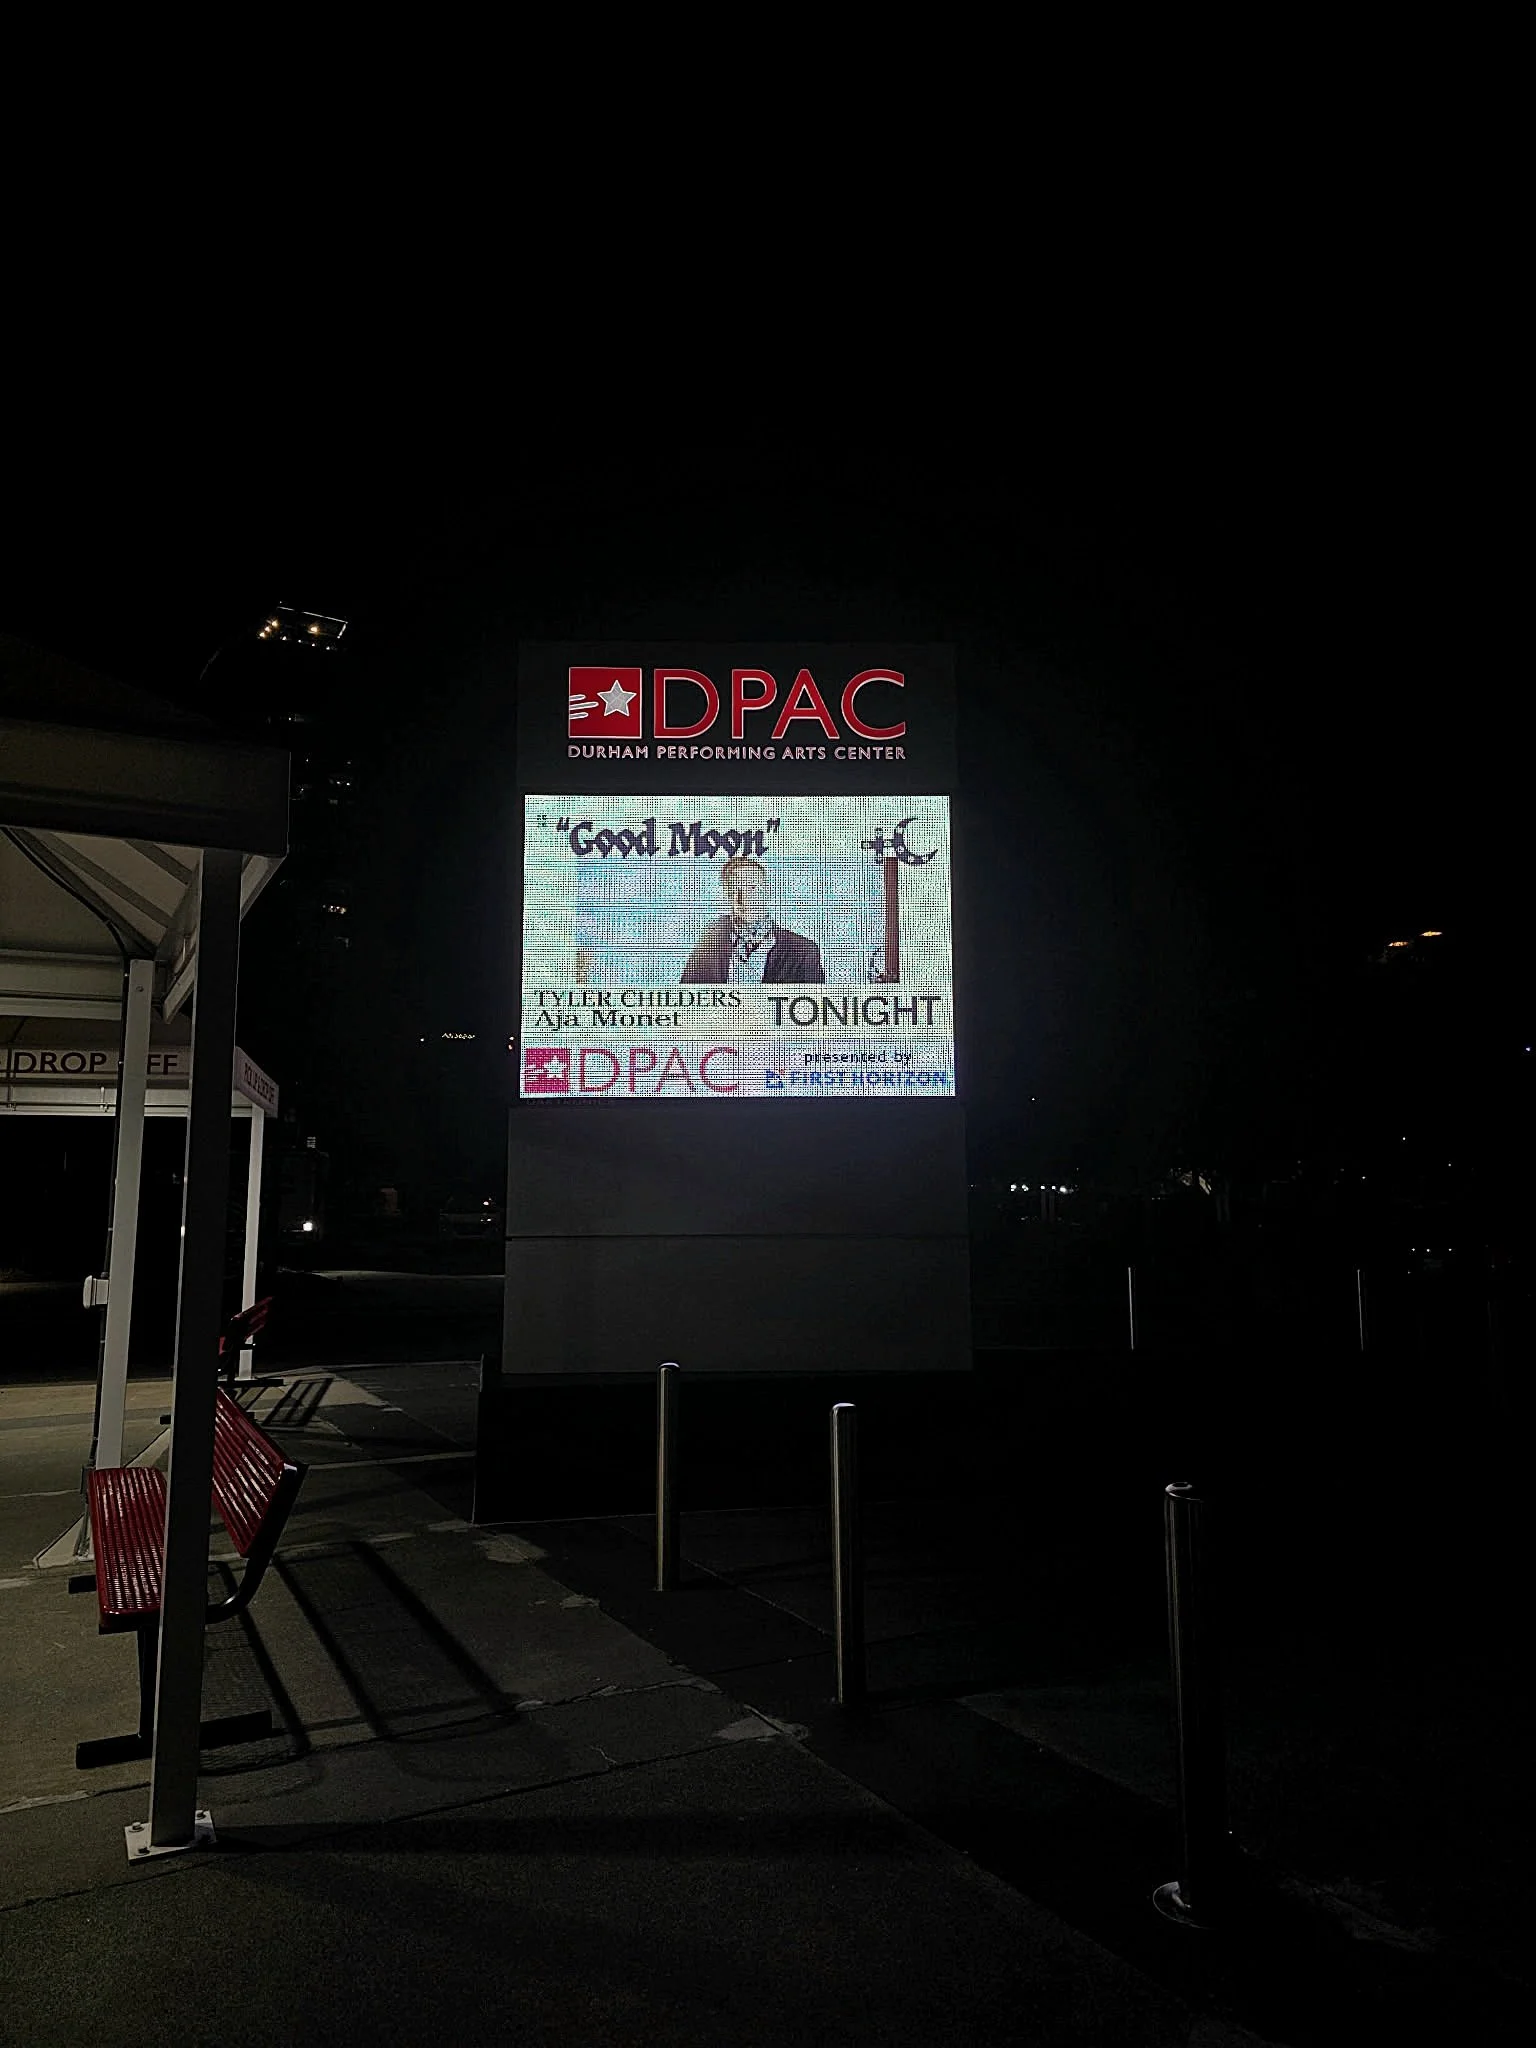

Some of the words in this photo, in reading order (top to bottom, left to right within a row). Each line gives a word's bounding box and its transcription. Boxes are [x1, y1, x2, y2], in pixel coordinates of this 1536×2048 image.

[653, 668, 906, 740] DPAC
[568, 745, 649, 759] DURHAM
[656, 746, 776, 760] PERFORMING
[781, 746, 826, 760] ARTS
[834, 746, 906, 760] CENTER
[534, 990, 616, 1007] TYLER
[620, 990, 741, 1008] CHILDERS
[534, 1010, 580, 1031] Aja
[592, 1010, 682, 1027] Monet
[767, 996, 942, 1026] TONIGHT
[14, 1052, 107, 1074] DROP
[147, 1054, 178, 1075] FF
[804, 1050, 887, 1065] presented
[893, 1050, 912, 1067] by
[579, 1046, 739, 1094] DPAC
[790, 1071, 847, 1087] FIRST
[851, 1071, 948, 1088] HORIZON
